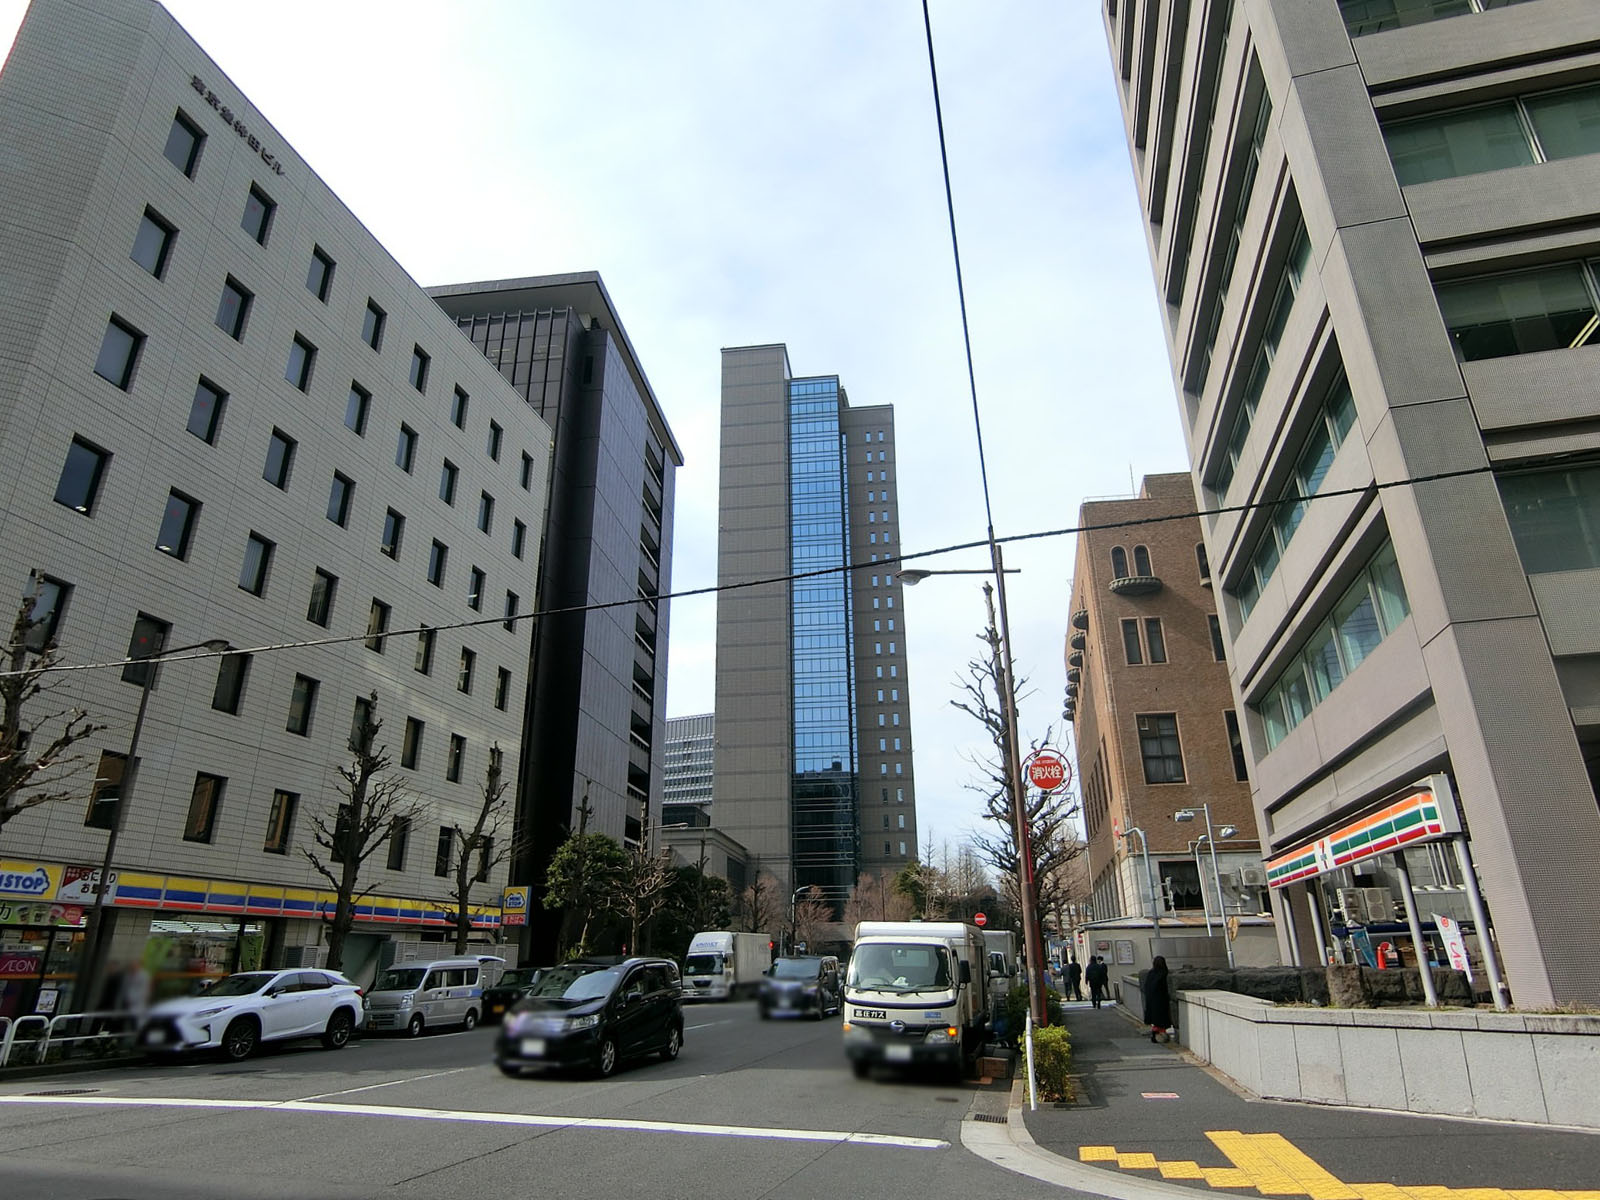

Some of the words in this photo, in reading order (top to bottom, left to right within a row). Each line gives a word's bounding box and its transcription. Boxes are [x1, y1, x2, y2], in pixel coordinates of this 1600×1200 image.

[1032, 765, 1062, 780] 消火栓
[80, 871, 117, 884] おにり
[855, 1009, 886, 1018] 高圧ガス
